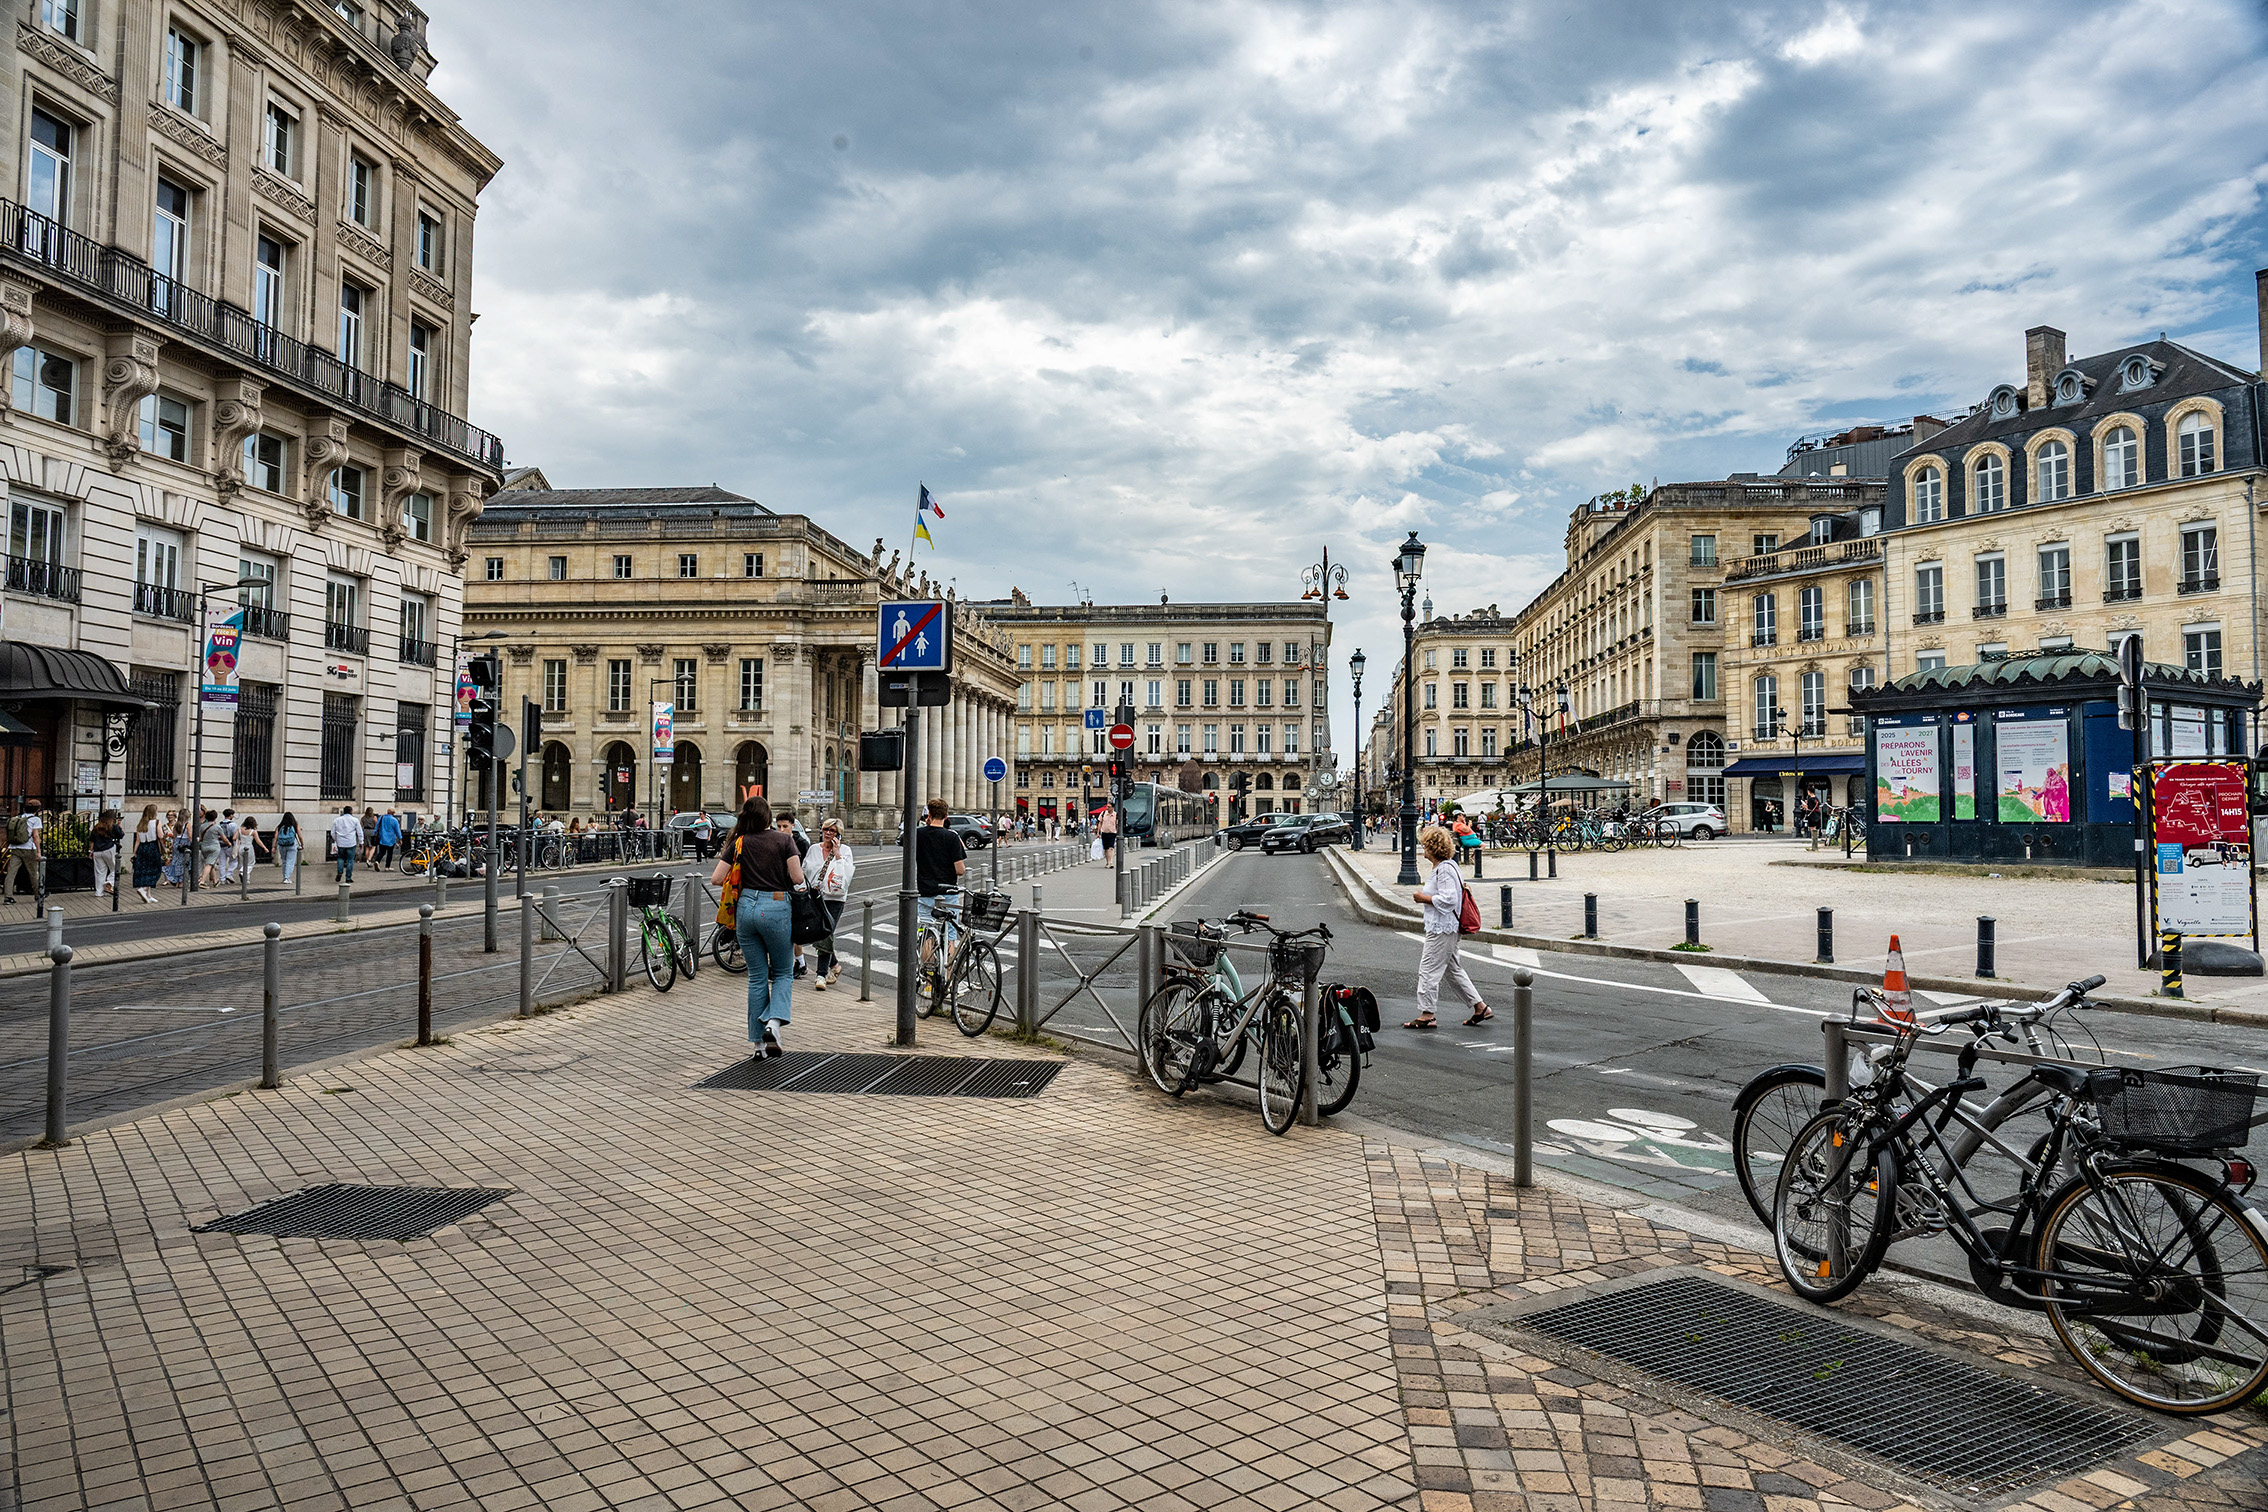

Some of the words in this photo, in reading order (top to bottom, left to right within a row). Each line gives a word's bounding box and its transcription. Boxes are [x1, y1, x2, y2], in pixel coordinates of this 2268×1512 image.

[214, 635, 233, 646] Vin
[1752, 638, 1874, 660] L'INTENDANT
[326, 665, 338, 676] SG
[1742, 741, 1780, 751] GRANDS
[1880, 741, 1926, 749] PRÉPARONS
[1900, 749, 1933, 757] L'AVENIR
[1890, 758, 1922, 767] ALLÉES
[1901, 767, 1934, 775] TOURNY
[2220, 808, 2243, 816] 14H15
[1913, 1149, 1936, 1176] GAZELLE
